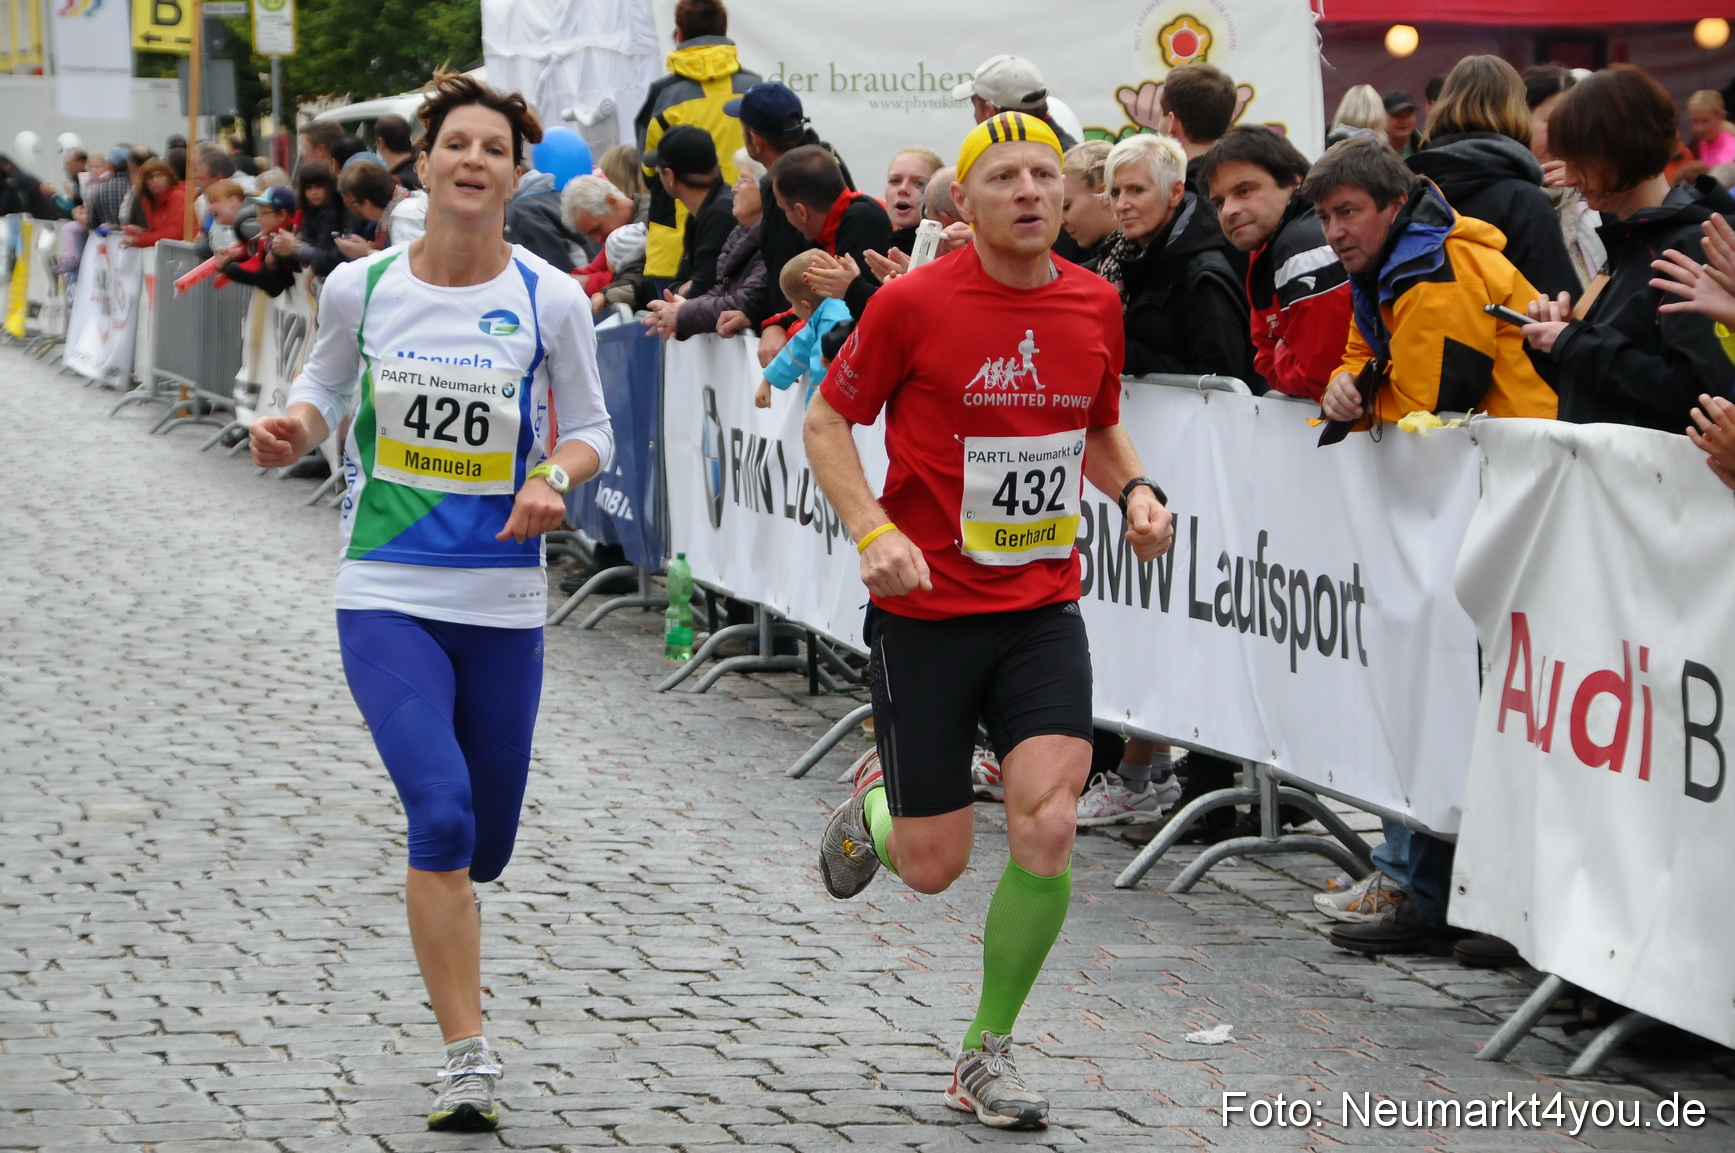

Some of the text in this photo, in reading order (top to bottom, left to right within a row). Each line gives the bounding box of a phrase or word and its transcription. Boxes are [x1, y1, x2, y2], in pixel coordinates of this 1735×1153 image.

[768, 61, 973, 92] der brauchen
[380, 369, 497, 395] PARTL Neumarkt
[837, 368, 858, 394] Trainer
[963, 393, 1092, 409] COMMITTED POWER
[403, 394, 491, 447] 426
[404, 449, 482, 477] Manuela
[967, 446, 1071, 463] PARTL Neumarkt
[991, 465, 1066, 516] 432
[994, 523, 1056, 548] Gerhard
[1075, 499, 1368, 674] BMW Laufsport
[1497, 611, 1654, 783] Audi
